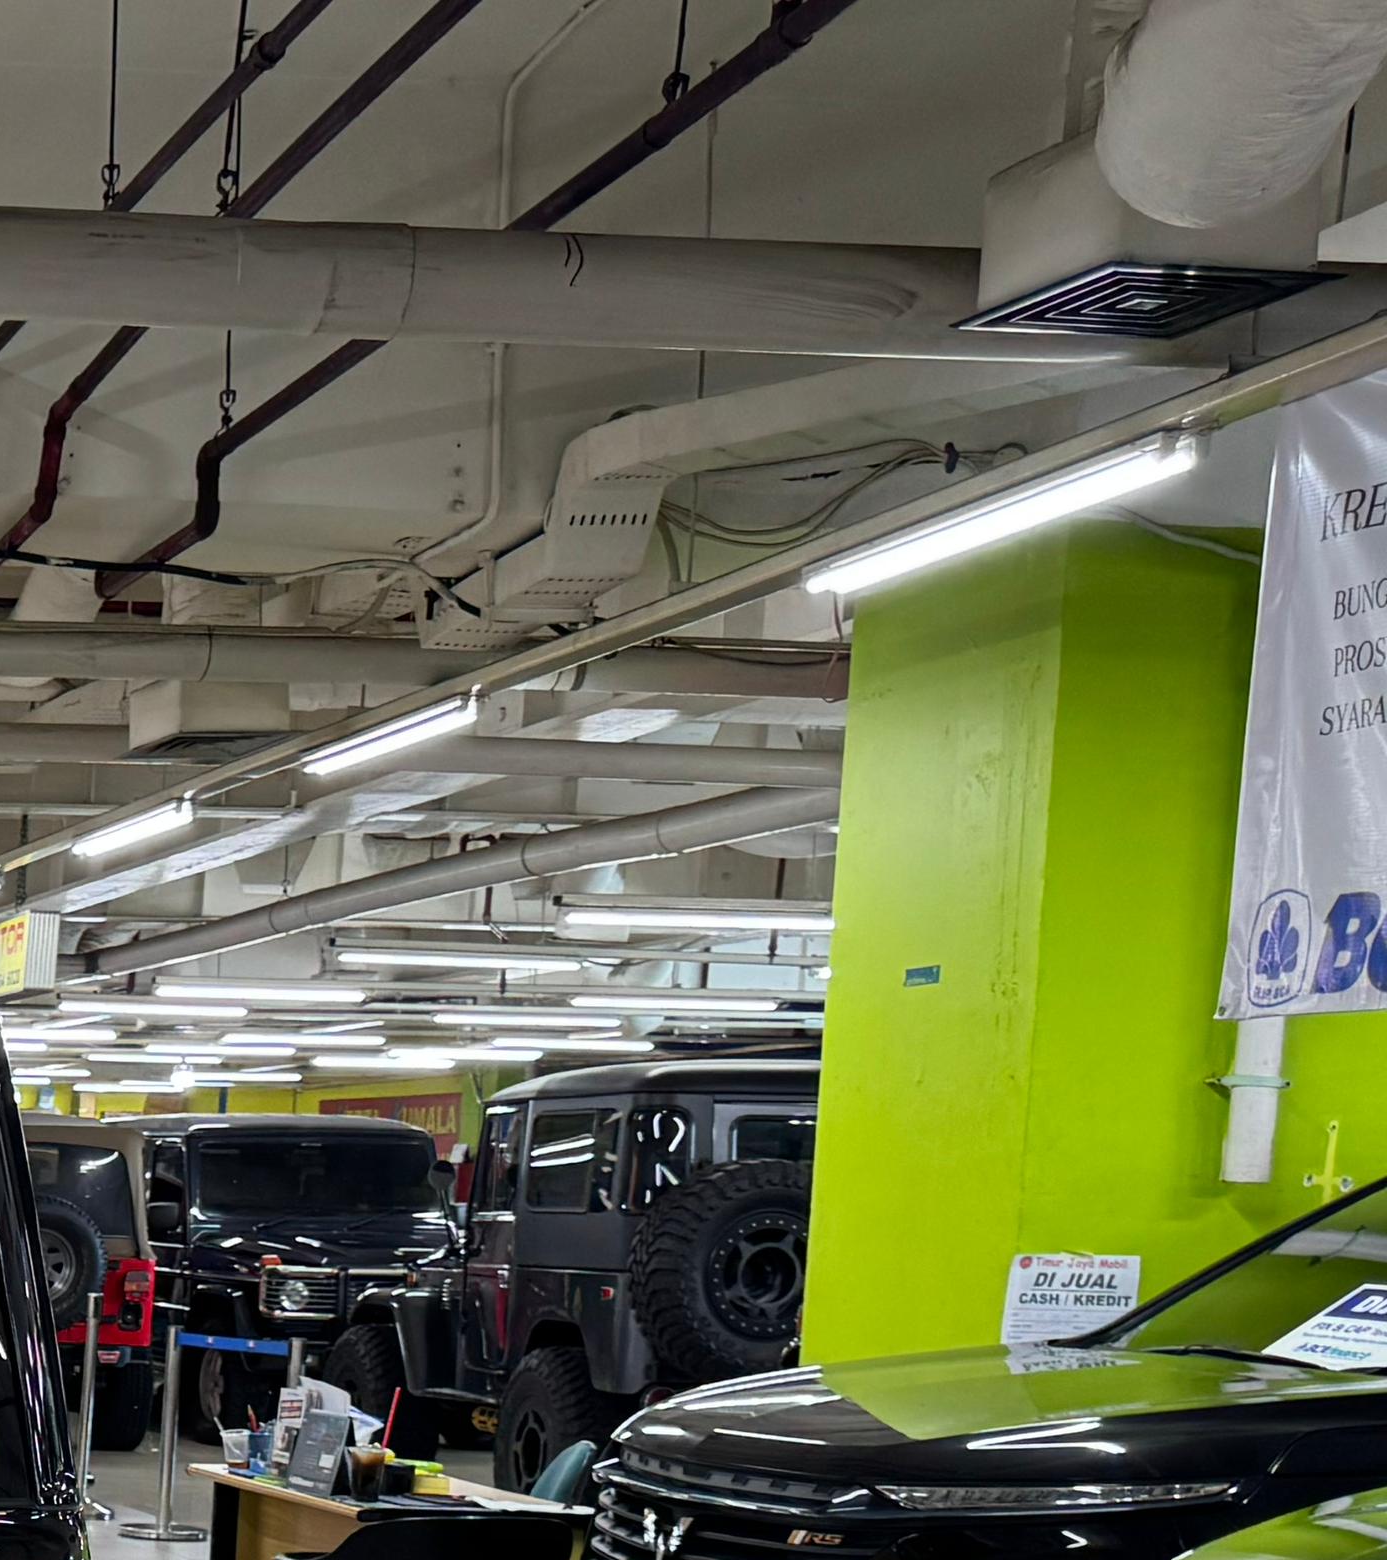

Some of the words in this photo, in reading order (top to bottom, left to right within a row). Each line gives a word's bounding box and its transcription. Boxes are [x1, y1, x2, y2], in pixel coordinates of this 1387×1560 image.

[1033, 1272, 1057, 1288] DI
[1060, 1273, 1119, 1290] JUAL
[1018, 1292, 1060, 1306] CASH
[1073, 1294, 1133, 1307] KREDIT
[804, 1531, 844, 1546] RS
